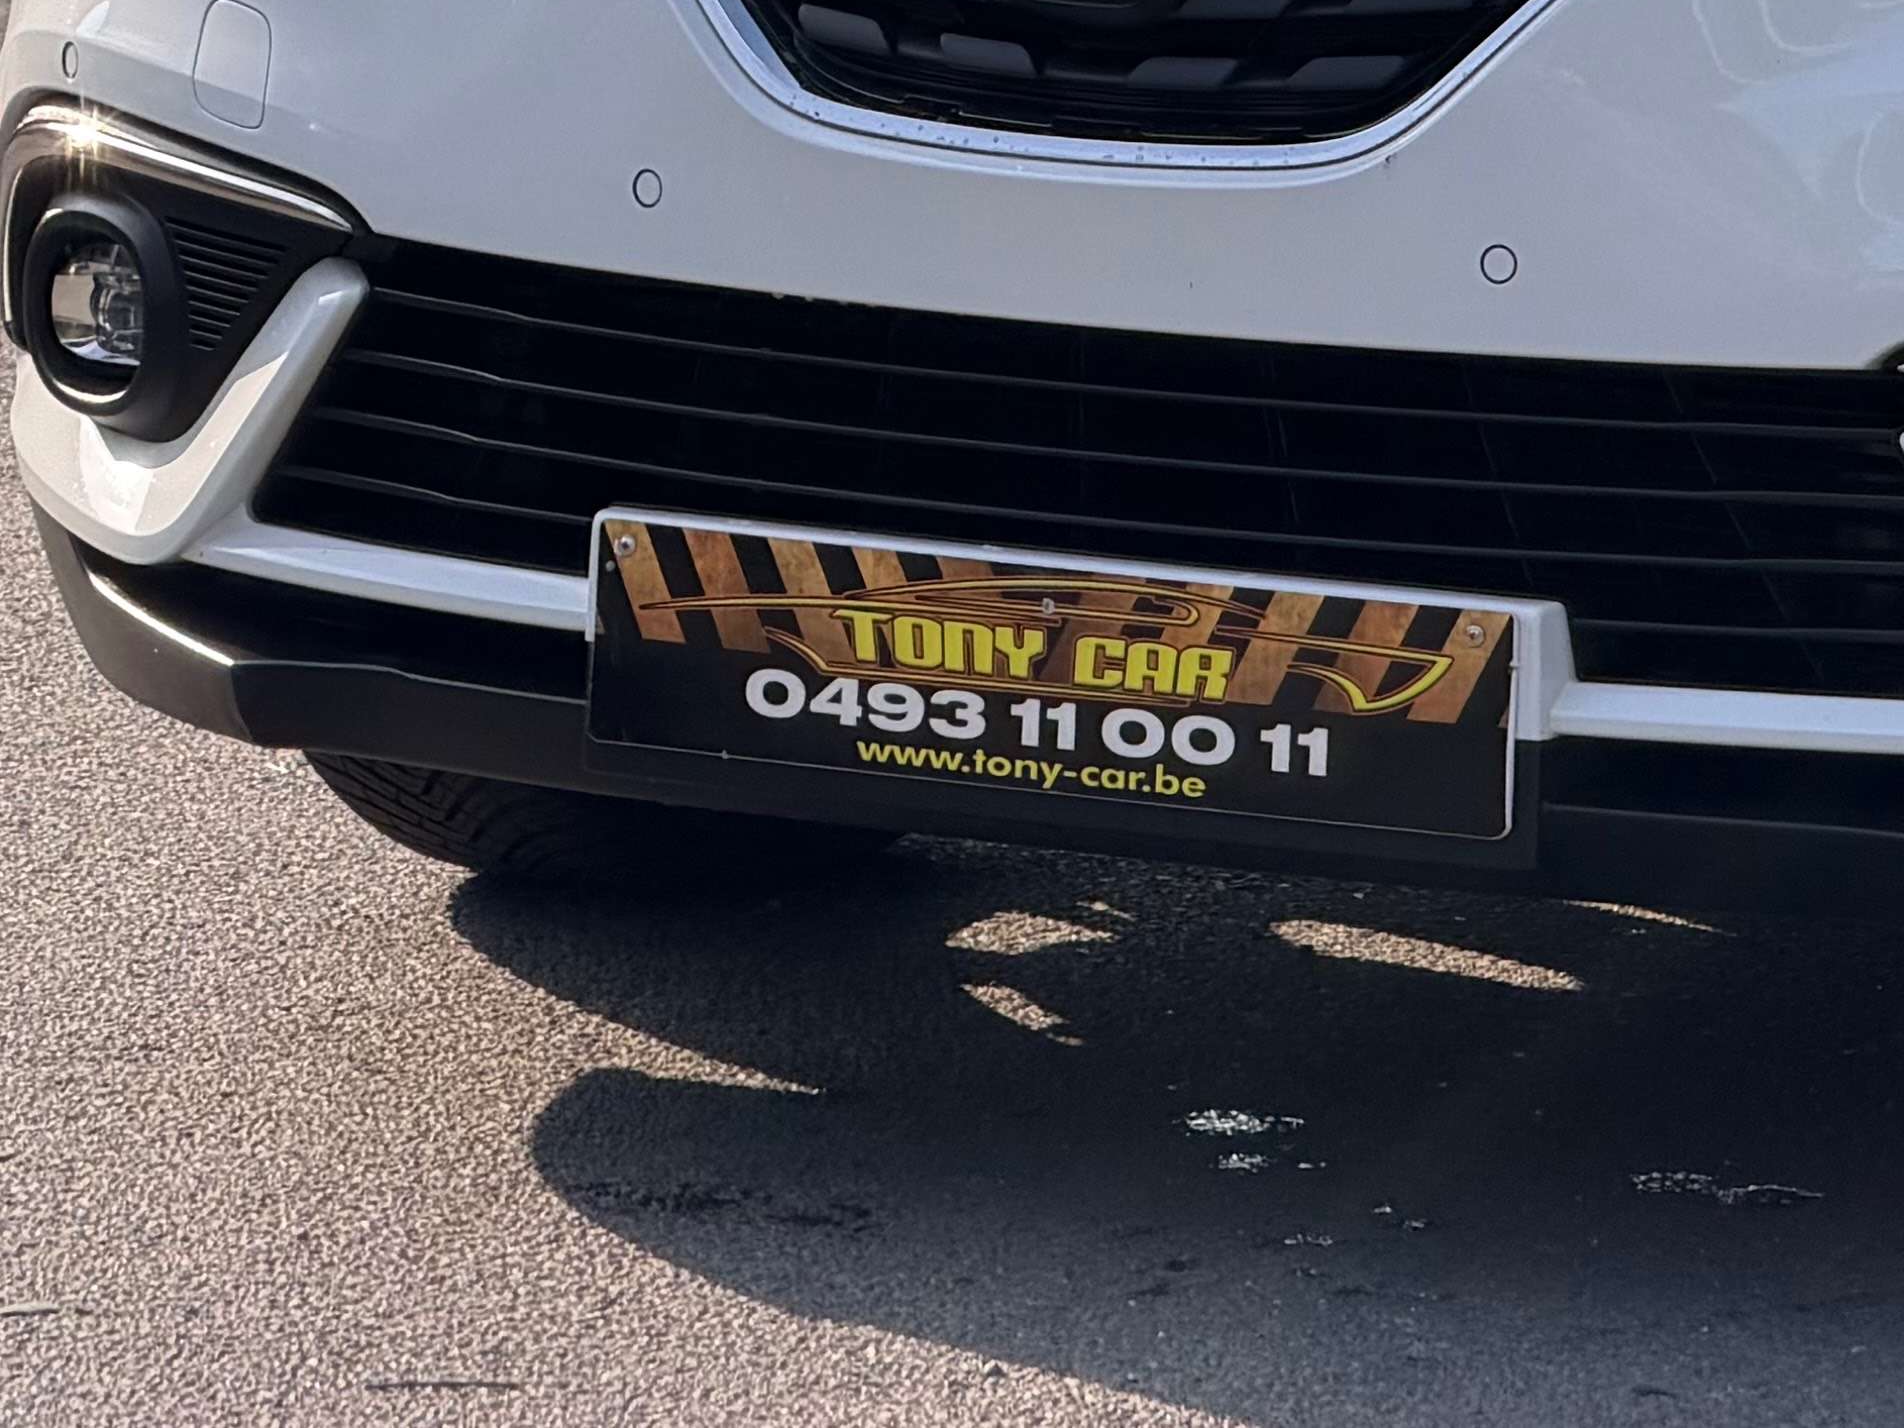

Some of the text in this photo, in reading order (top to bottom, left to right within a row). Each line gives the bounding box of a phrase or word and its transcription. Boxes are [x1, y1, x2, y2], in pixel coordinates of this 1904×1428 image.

[831, 609, 1231, 700] TONY CAR
[743, 667, 1329, 778] 0493 11 00 11
[856, 738, 1206, 800] www.tony-car.be
